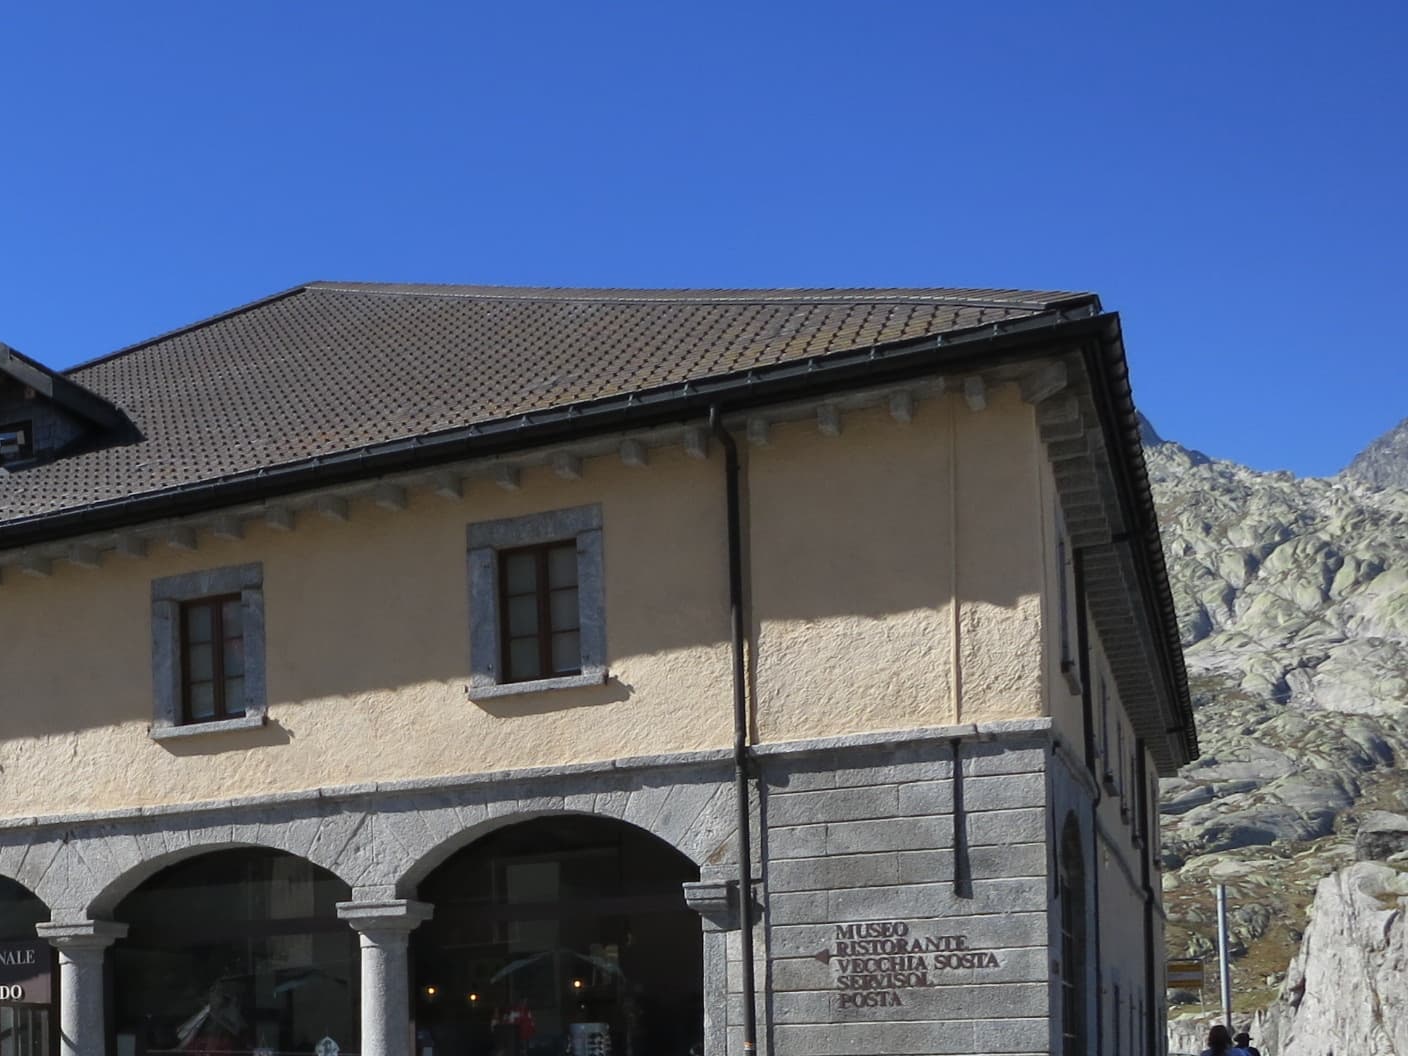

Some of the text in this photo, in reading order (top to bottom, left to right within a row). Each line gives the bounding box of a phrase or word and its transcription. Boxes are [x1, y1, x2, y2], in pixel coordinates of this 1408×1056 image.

[835, 921, 909, 940] MUSEO
[835, 935, 969, 957] RISTORANTE
[838, 952, 1000, 974] VECCHIA SOSTA
[839, 991, 903, 1009] POSTA
